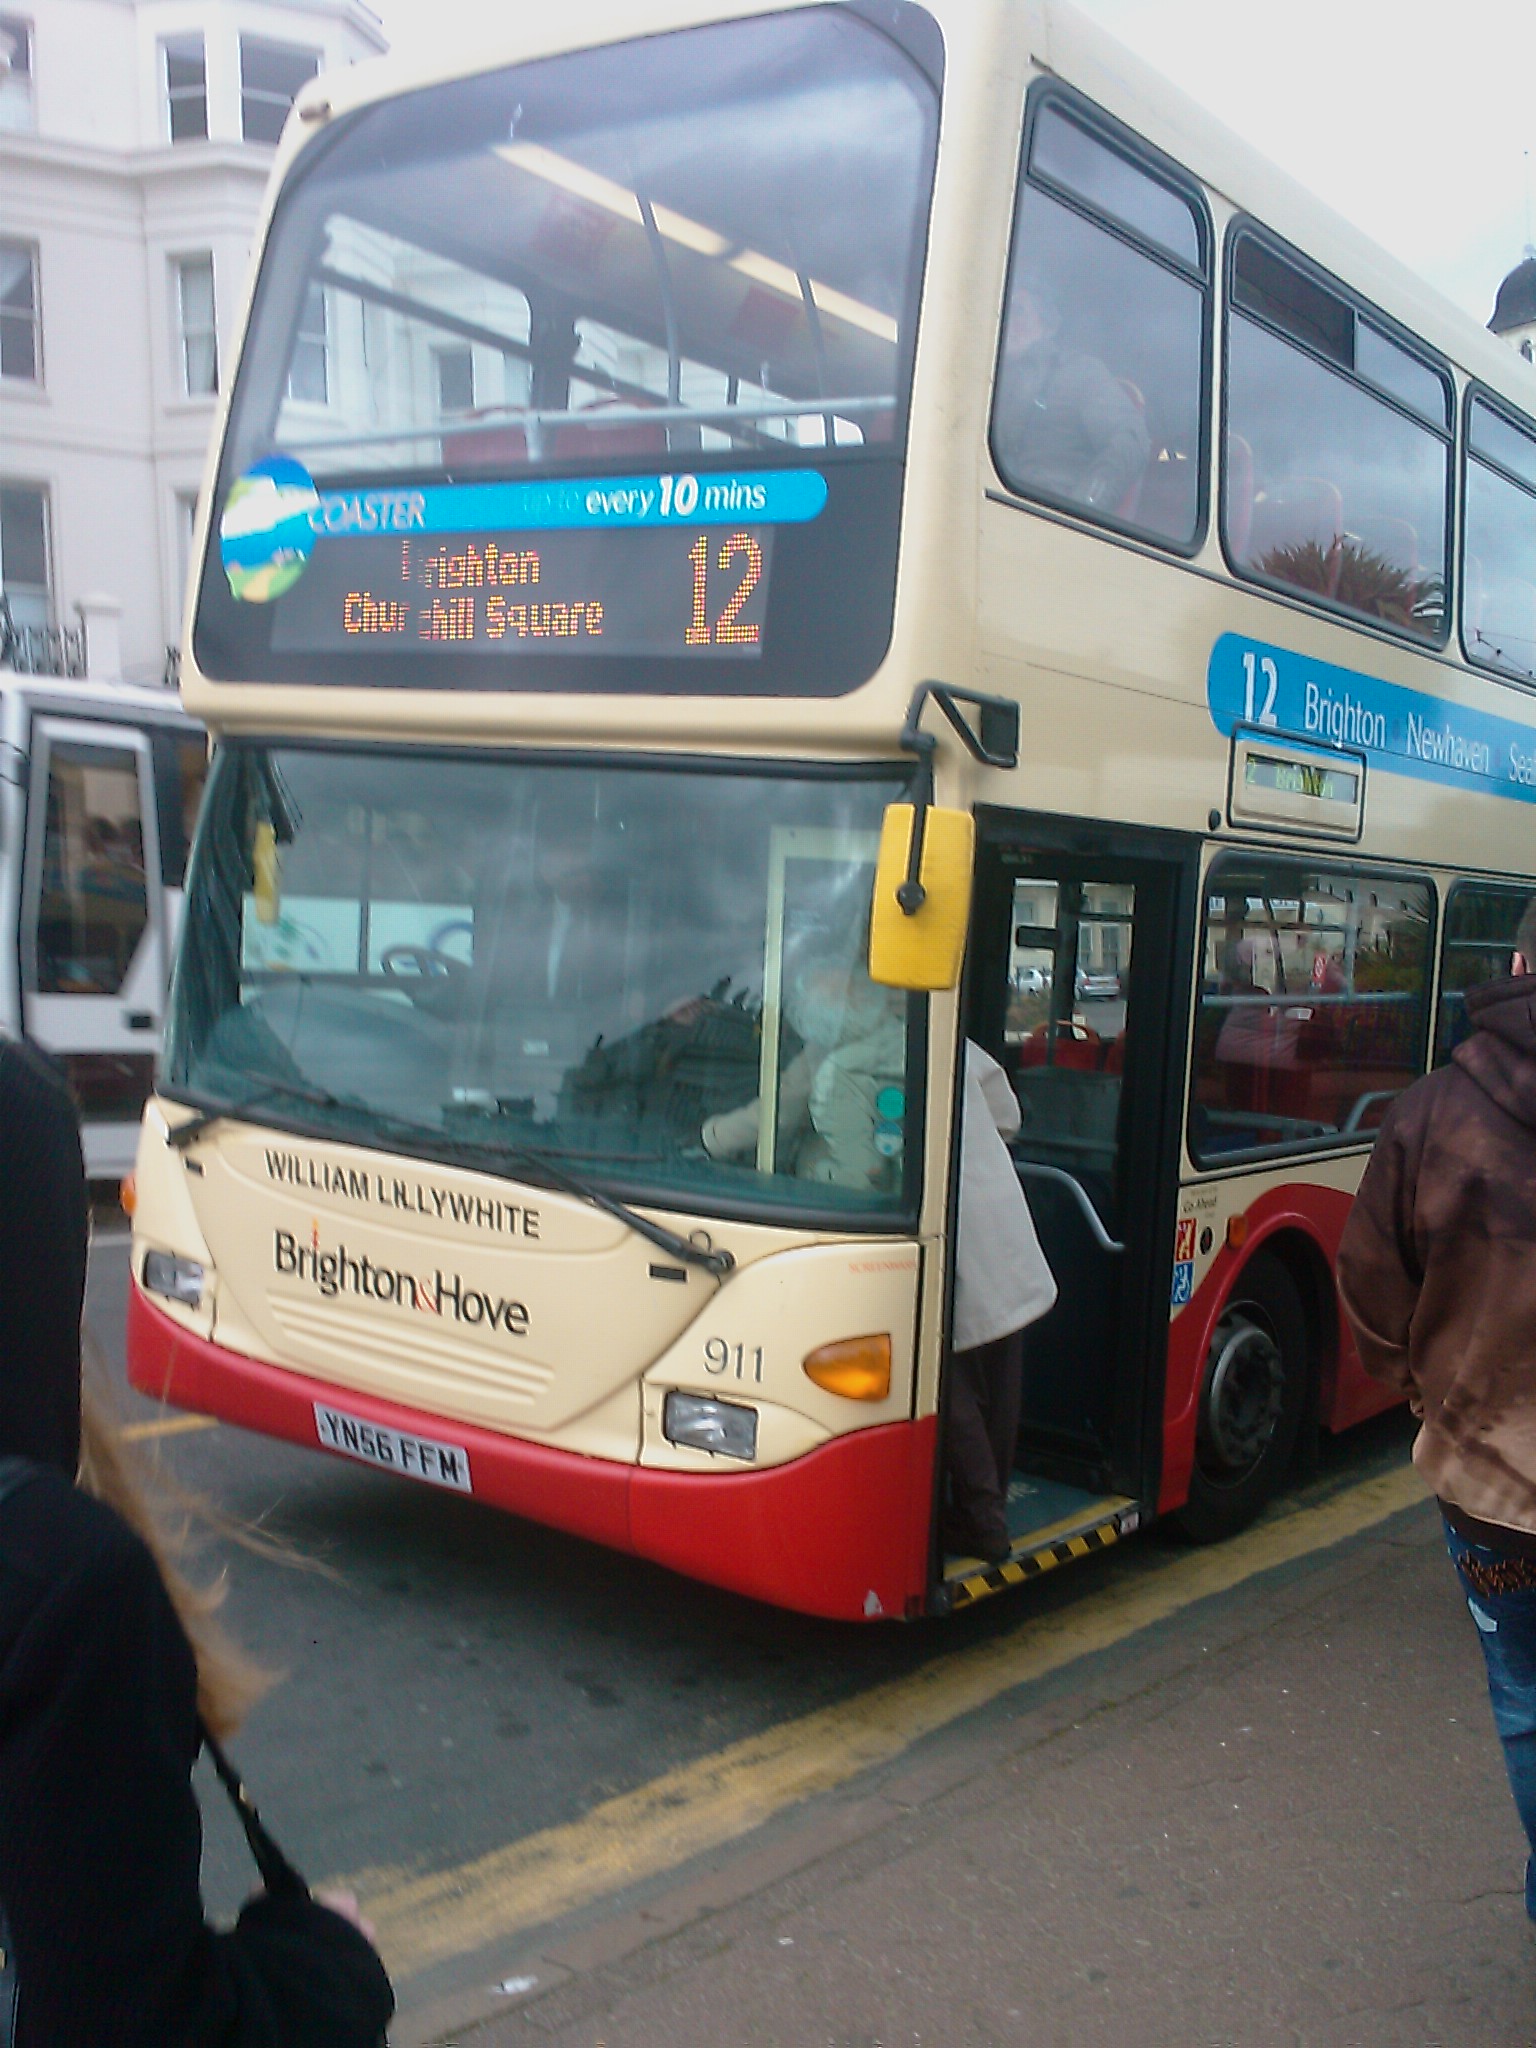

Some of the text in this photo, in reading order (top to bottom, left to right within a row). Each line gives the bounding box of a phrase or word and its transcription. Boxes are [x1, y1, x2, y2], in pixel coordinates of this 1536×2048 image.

[584, 490, 654, 518] every
[659, 474, 698, 517] 10
[704, 479, 767, 510] mins
[485, 595, 604, 640] Square
[685, 532, 762, 646] 12
[1242, 652, 1280, 728] 12
[1304, 681, 1387, 750] Brighton
[1405, 711, 1490, 773] Newhaven
[264, 1149, 542, 1241] WILLIAM LILLYWHITE
[703, 1337, 763, 1383] 911
[323, 1410, 461, 1485] YN56 FFM
